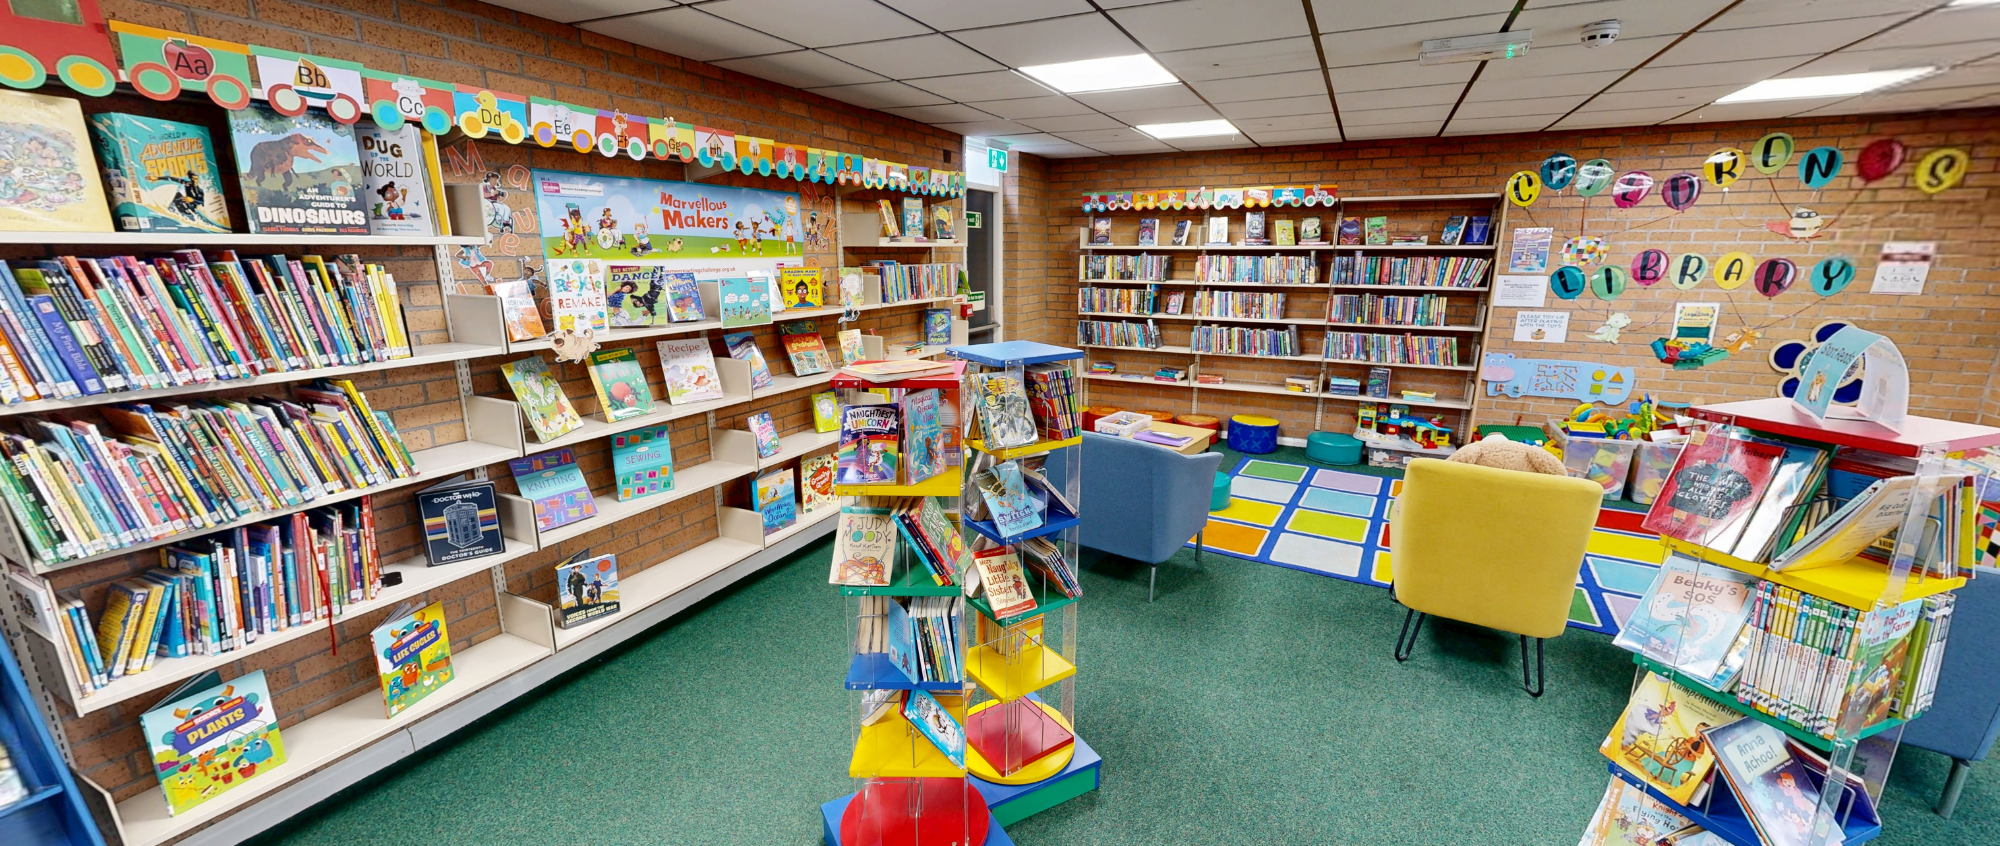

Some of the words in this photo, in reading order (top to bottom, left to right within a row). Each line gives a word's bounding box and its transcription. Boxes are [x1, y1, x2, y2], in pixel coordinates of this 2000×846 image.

[174, 51, 209, 77] Aa
[297, 65, 327, 88] Bb
[399, 97, 424, 116] Cc
[481, 108, 502, 126] Dd
[554, 120, 571, 136] Ee
[139, 137, 203, 162] ADVENTURE
[362, 136, 403, 158] DUG
[617, 135, 629, 148] Ff
[668, 138, 681, 152] Gg
[710, 142, 722, 156] Hh
[144, 152, 208, 178] SPORTS
[360, 161, 413, 178] WORLD
[299, 194, 356, 202] ADVENTURER'S
[660, 191, 727, 211] Marvellous
[257, 206, 366, 225] DINOSAURS
[662, 209, 728, 230] Makers
[612, 272, 657, 282] DANCE
[1557, 250, 1849, 294] LIBRARY
[558, 297, 601, 309] REMAKE
[50, 318, 67, 336] My
[59, 332, 76, 353] First
[70, 350, 87, 372] Bible
[667, 343, 701, 353] Recipe
[911, 392, 933, 409] Magical
[849, 408, 895, 420] NAUGHTIEST
[260, 418, 279, 446] GROWING
[851, 418, 889, 429] UNICORN
[247, 431, 267, 459] NADIYA'S
[625, 450, 661, 465] SEWING
[211, 458, 239, 499] GARDENING
[526, 472, 577, 493] KNITTING
[1689, 471, 1709, 481] THE
[432, 495, 462, 503] DOCTOR
[462, 491, 482, 499] WHO
[1677, 490, 1727, 508] CLOTHES
[857, 516, 892, 531] JUDY
[441, 552, 473, 561] DOCTOR'S
[474, 547, 493, 555] GUIDE
[986, 560, 1019, 574] Naughty
[987, 575, 1010, 584] Little
[1673, 575, 1738, 596] Beaky's
[988, 585, 1012, 597] Sister
[1683, 590, 1717, 605] SOS
[566, 610, 586, 620] VOICES
[566, 614, 587, 625] SECOND
[587, 608, 606, 617] WORLD
[1893, 620, 1911, 632] Farm
[392, 648, 411, 663] LIFE
[408, 630, 437, 654] CYCLES
[186, 708, 245, 745] PLANTS
[1736, 734, 1765, 757] Anna
[1744, 745, 1778, 773] Achoo!
[1632, 806, 1661, 825] Fying
[1663, 819, 1680, 831] Ho
